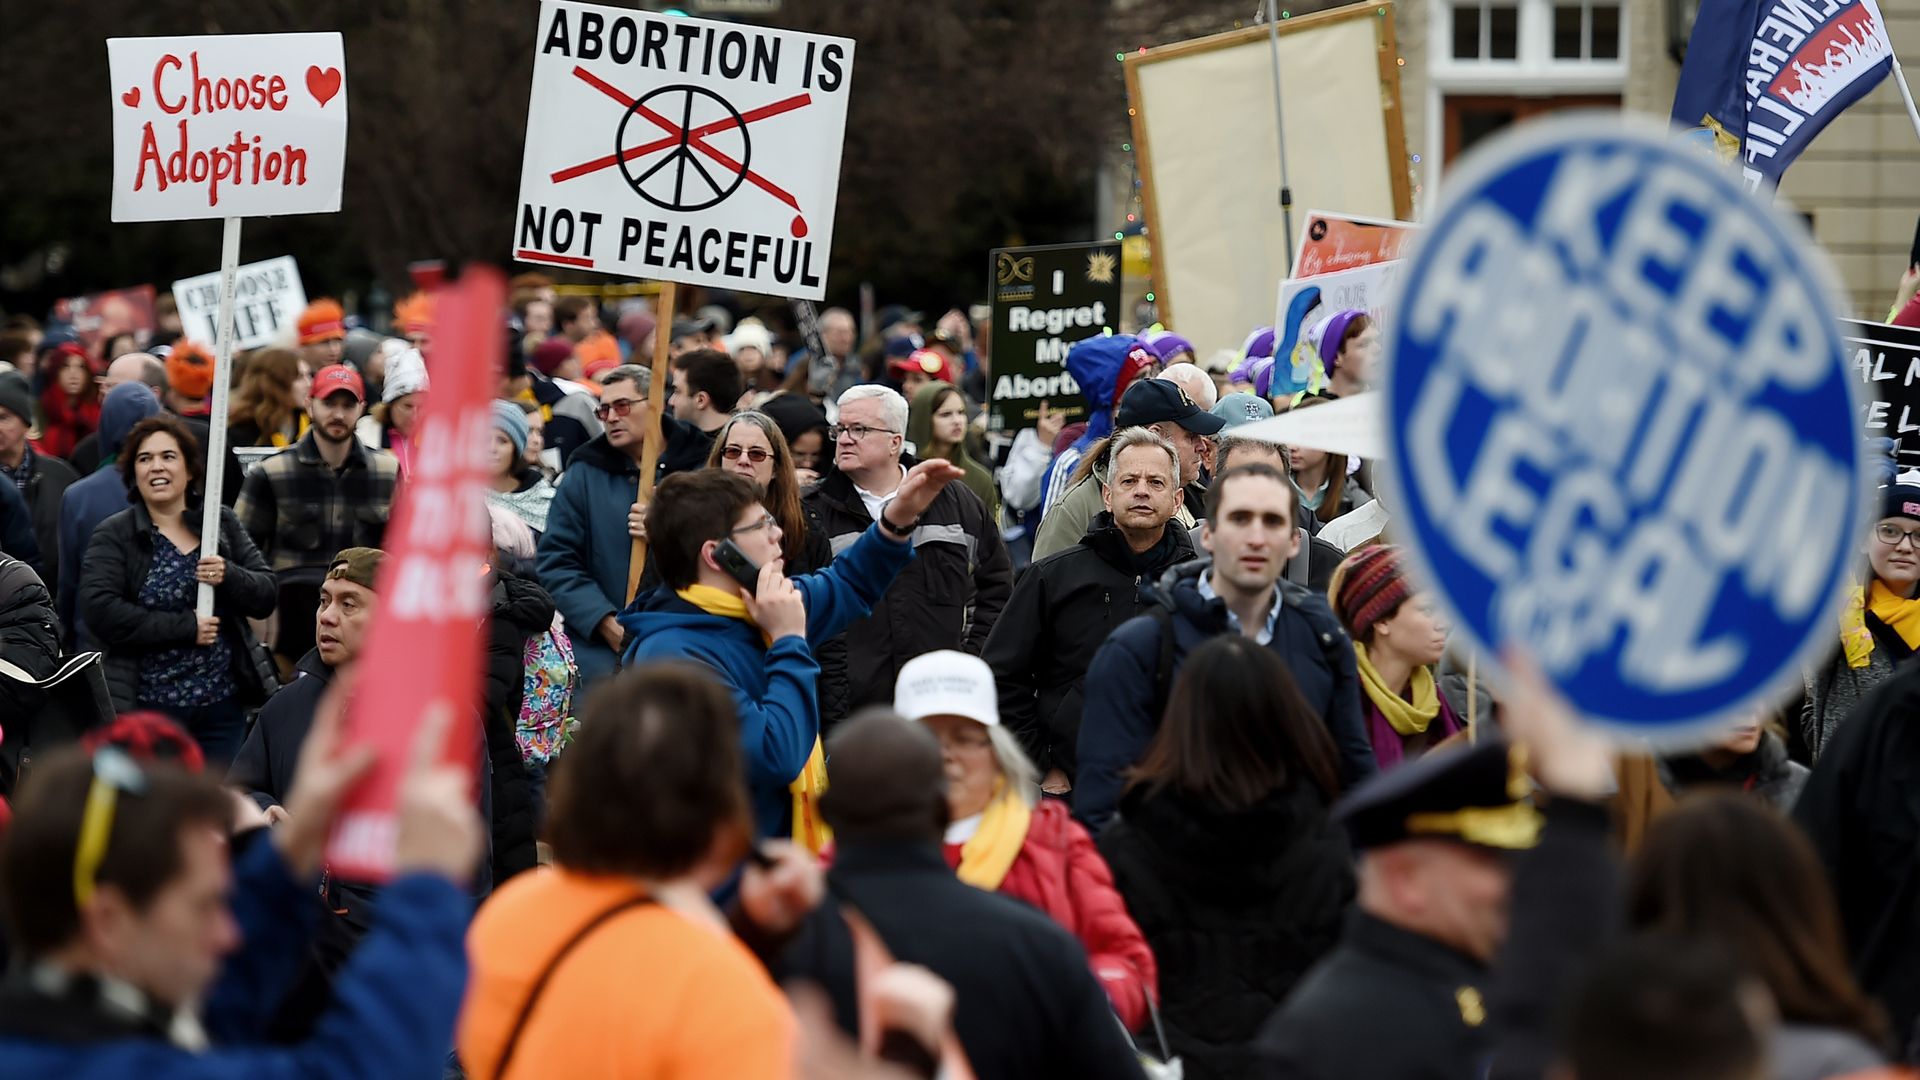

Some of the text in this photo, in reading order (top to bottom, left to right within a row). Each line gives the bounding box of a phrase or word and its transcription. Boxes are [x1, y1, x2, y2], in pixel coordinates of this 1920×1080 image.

[543, 9, 843, 92] ABORTION IS
[154, 52, 288, 114] Choose
[136, 120, 307, 205] Adoption
[520, 204, 819, 287] NOT PEACEFUL
[1533, 148, 1832, 398] KEEP
[186, 268, 288, 309] CHOSE
[1052, 270, 1064, 295] I
[1009, 301, 1106, 335] Regret
[1036, 337, 1077, 367] My
[1852, 348, 1898, 383] AL
[1406, 366, 1746, 692] LEGAL
